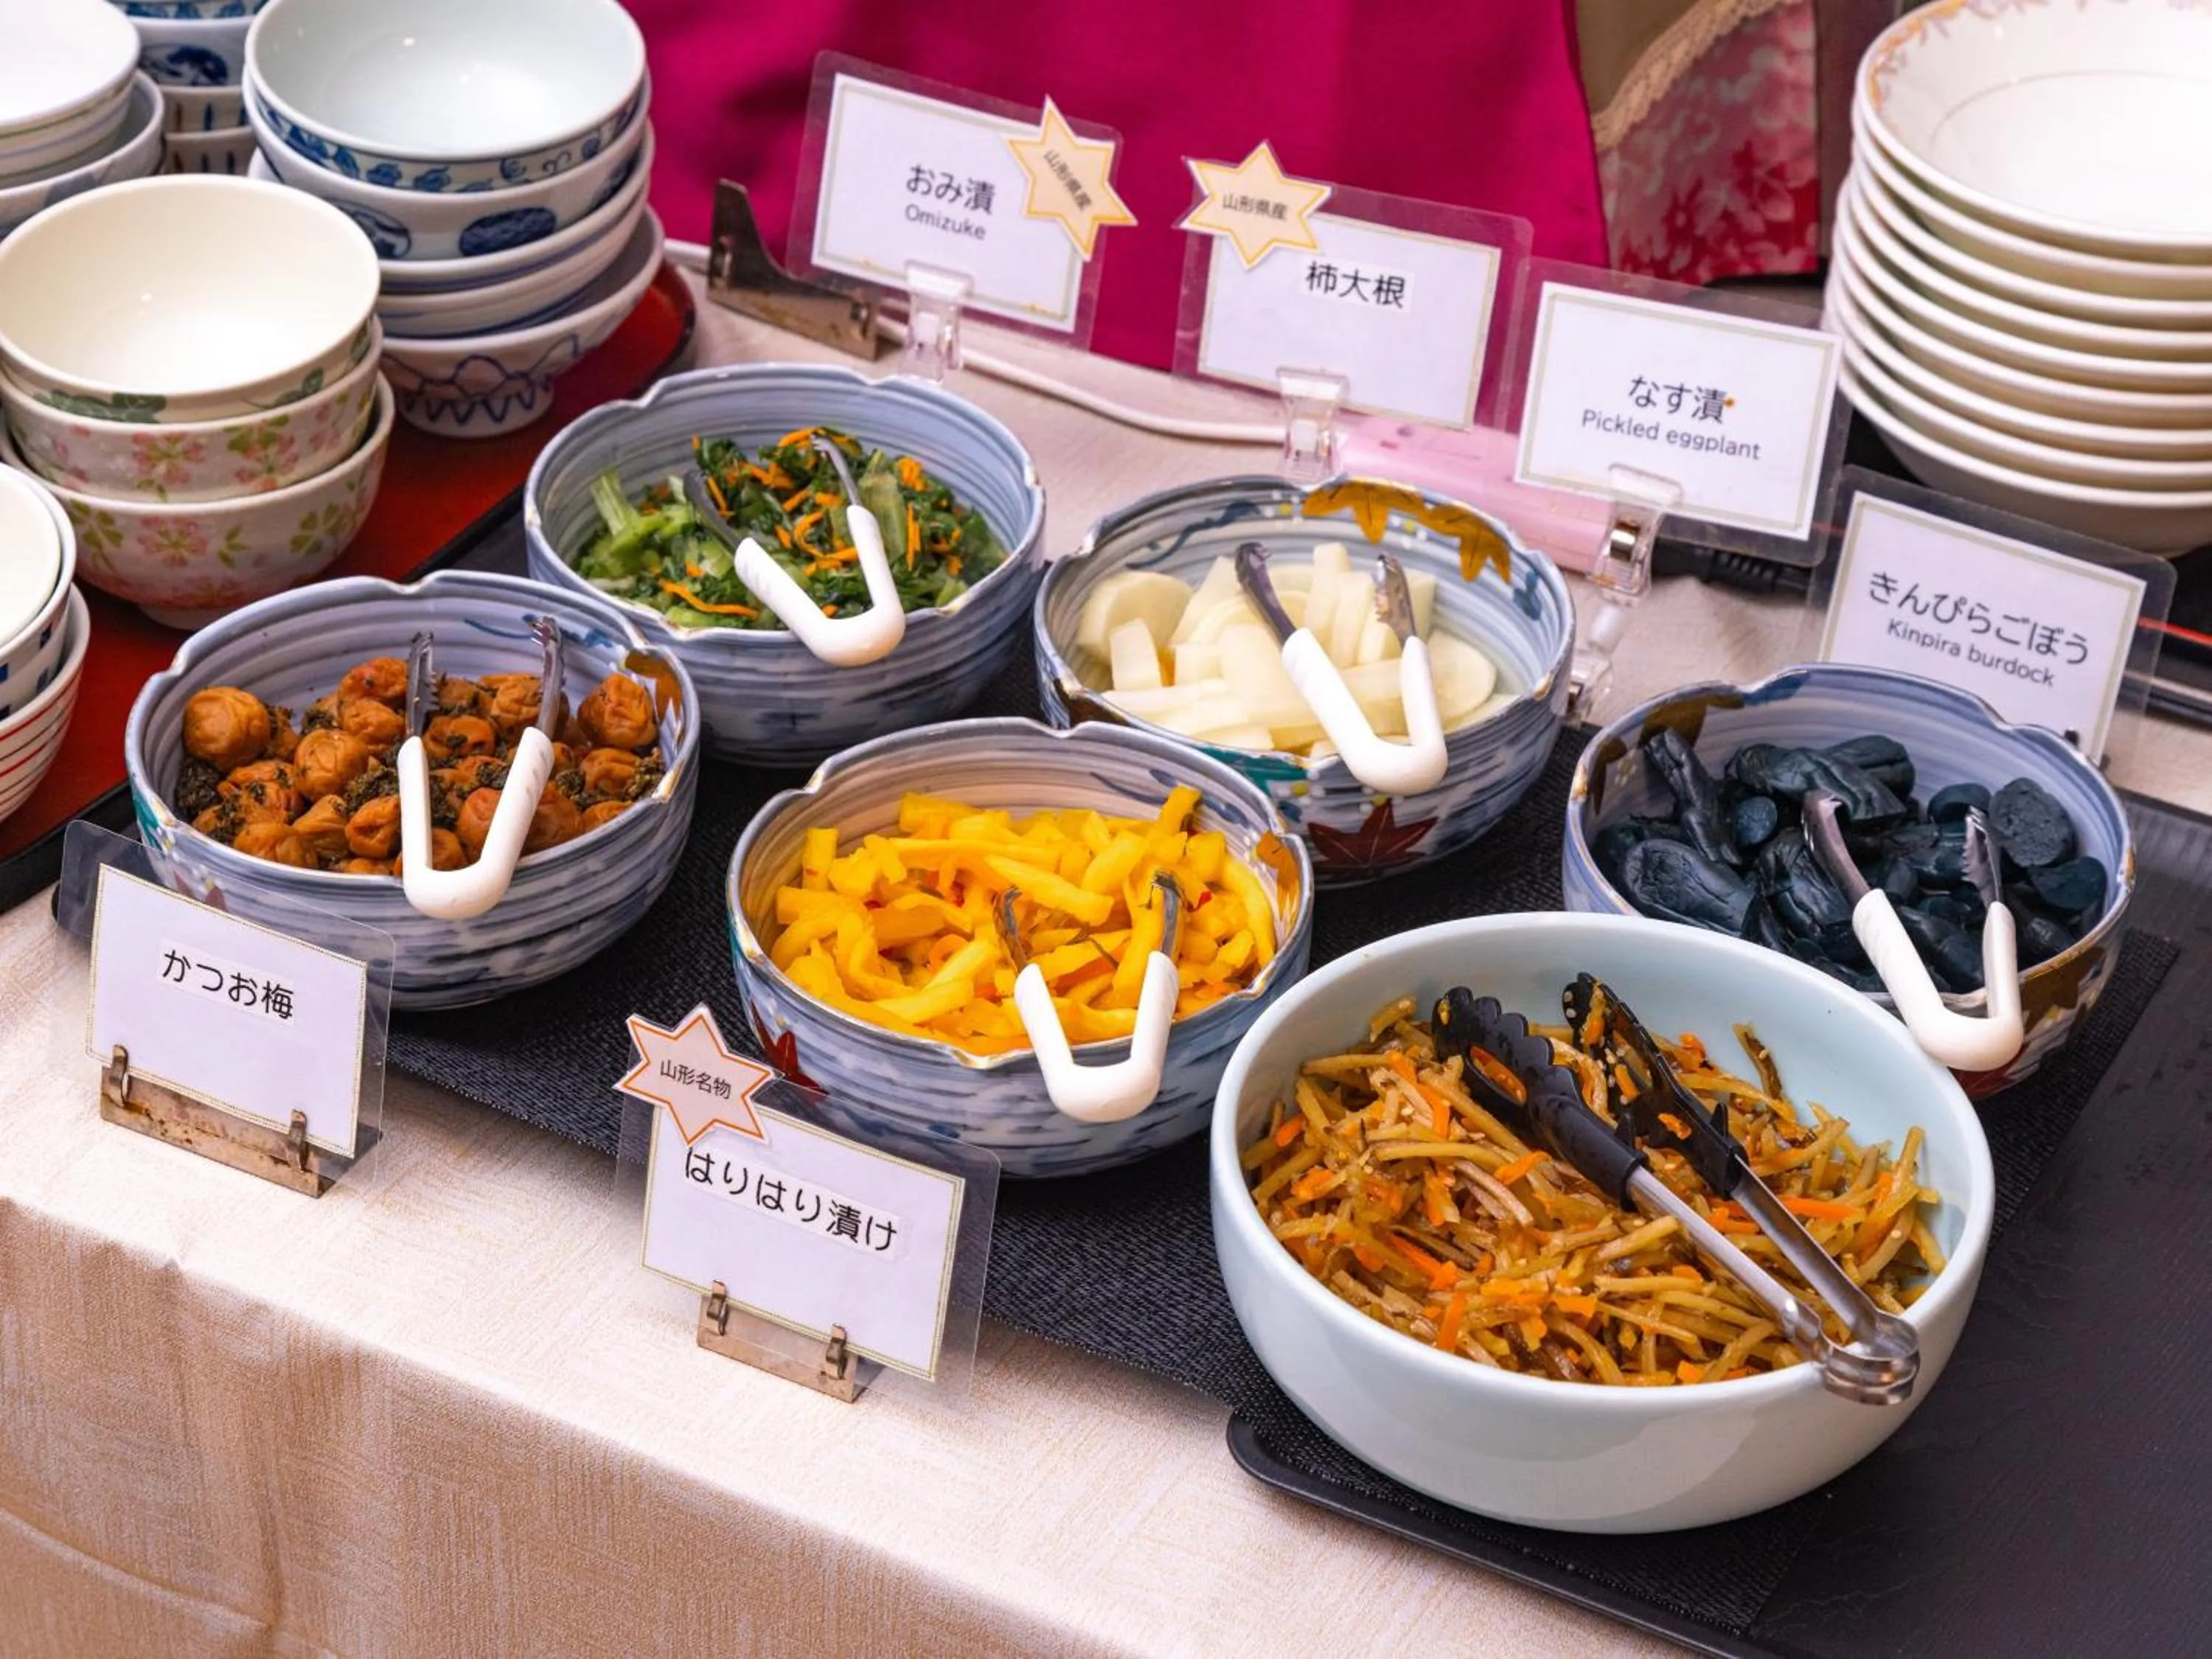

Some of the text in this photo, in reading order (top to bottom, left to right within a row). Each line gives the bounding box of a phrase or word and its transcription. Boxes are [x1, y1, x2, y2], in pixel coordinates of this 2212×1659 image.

[906, 164, 995, 215] おみ漬
[1043, 149, 1093, 211] 山形県産
[905, 204, 987, 240] Omizuke
[1222, 194, 1288, 221] 山形県産
[1305, 260, 1406, 308] 柿大根
[1628, 375, 1726, 425] なす漬
[1582, 408, 1761, 461] Pickled eggplant
[1868, 571, 2088, 664] きんぴらごぼう
[1887, 617, 2055, 687] Kinpira burdock
[162, 949, 294, 1020] かつお梅
[659, 1060, 731, 1100] 山形名物
[685, 1147, 897, 1251] はりはり漬け
